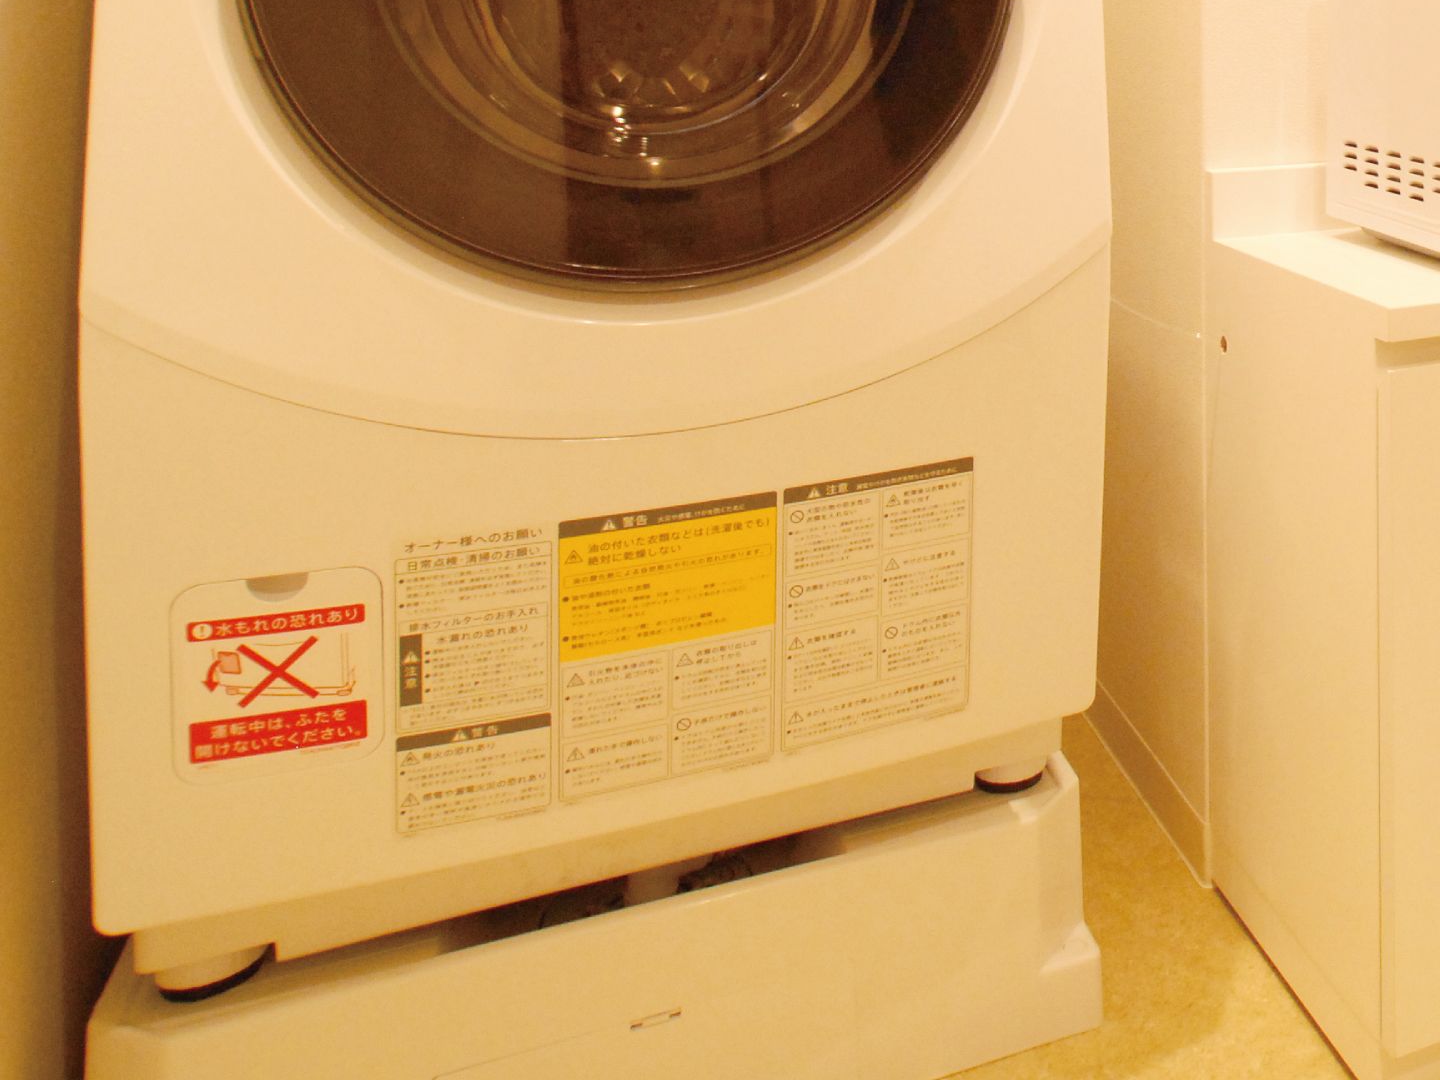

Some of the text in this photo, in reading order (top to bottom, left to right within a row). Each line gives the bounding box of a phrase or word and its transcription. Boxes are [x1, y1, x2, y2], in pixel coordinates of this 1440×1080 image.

[403, 526, 544, 554] オーナー様へのお願い
[587, 544, 682, 566] 絶対に乾燥しない
[214, 608, 360, 637] 水もれの恐れあり
[193, 725, 362, 761] 開けないでください。
